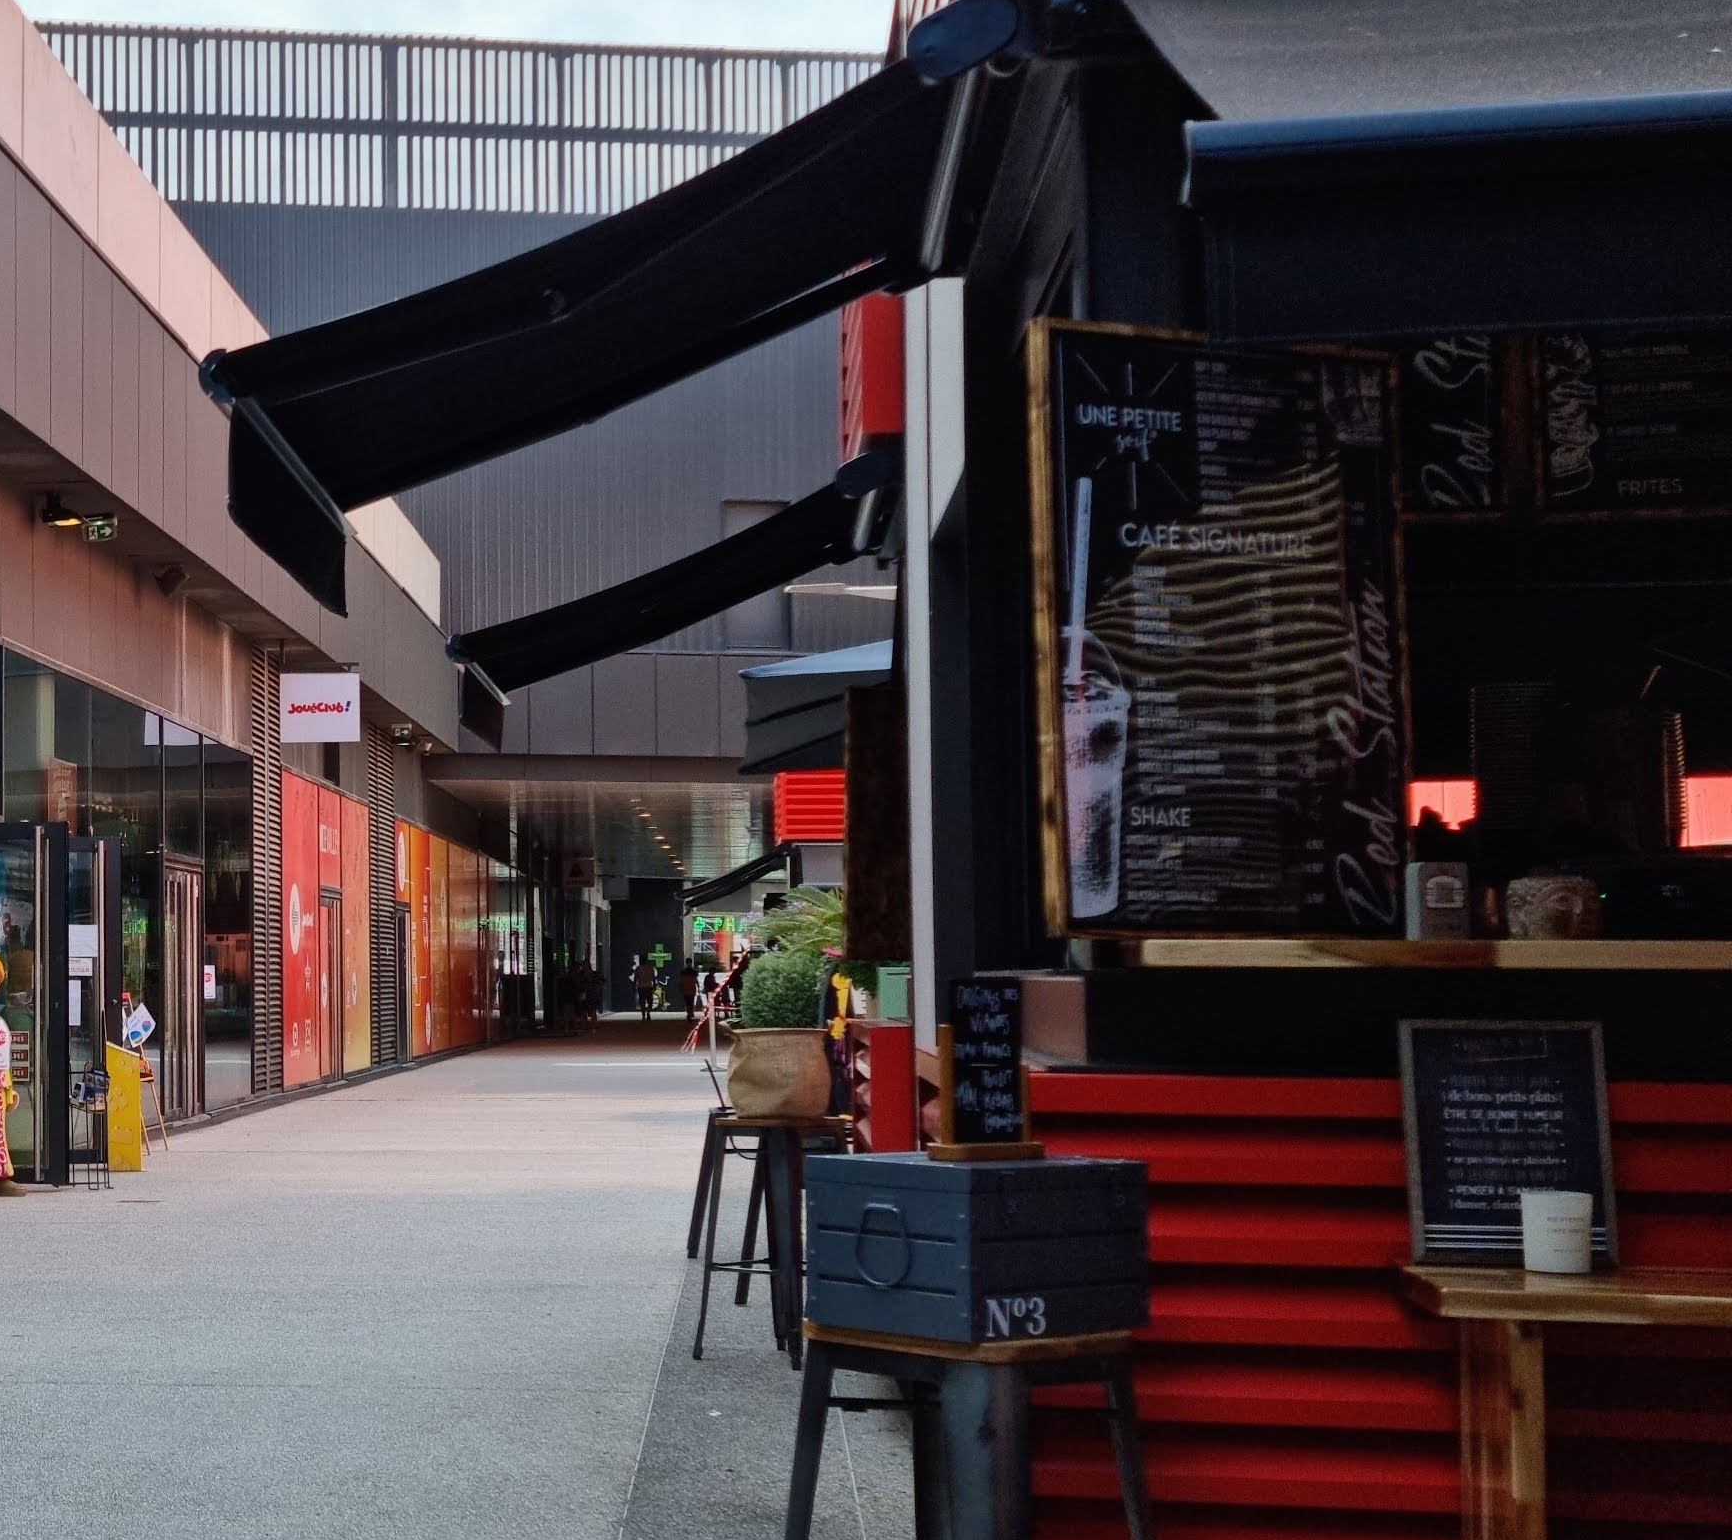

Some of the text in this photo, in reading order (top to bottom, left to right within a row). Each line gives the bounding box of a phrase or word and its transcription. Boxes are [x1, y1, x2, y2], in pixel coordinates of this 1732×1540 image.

[1078, 403, 1116, 427] UNE
[1122, 407, 1182, 433] PETITE
[1618, 477, 1683, 495] FRITES
[1118, 519, 1312, 557] CAFÉ SIGNATURE
[1129, 806, 1191, 827] SHAKE
